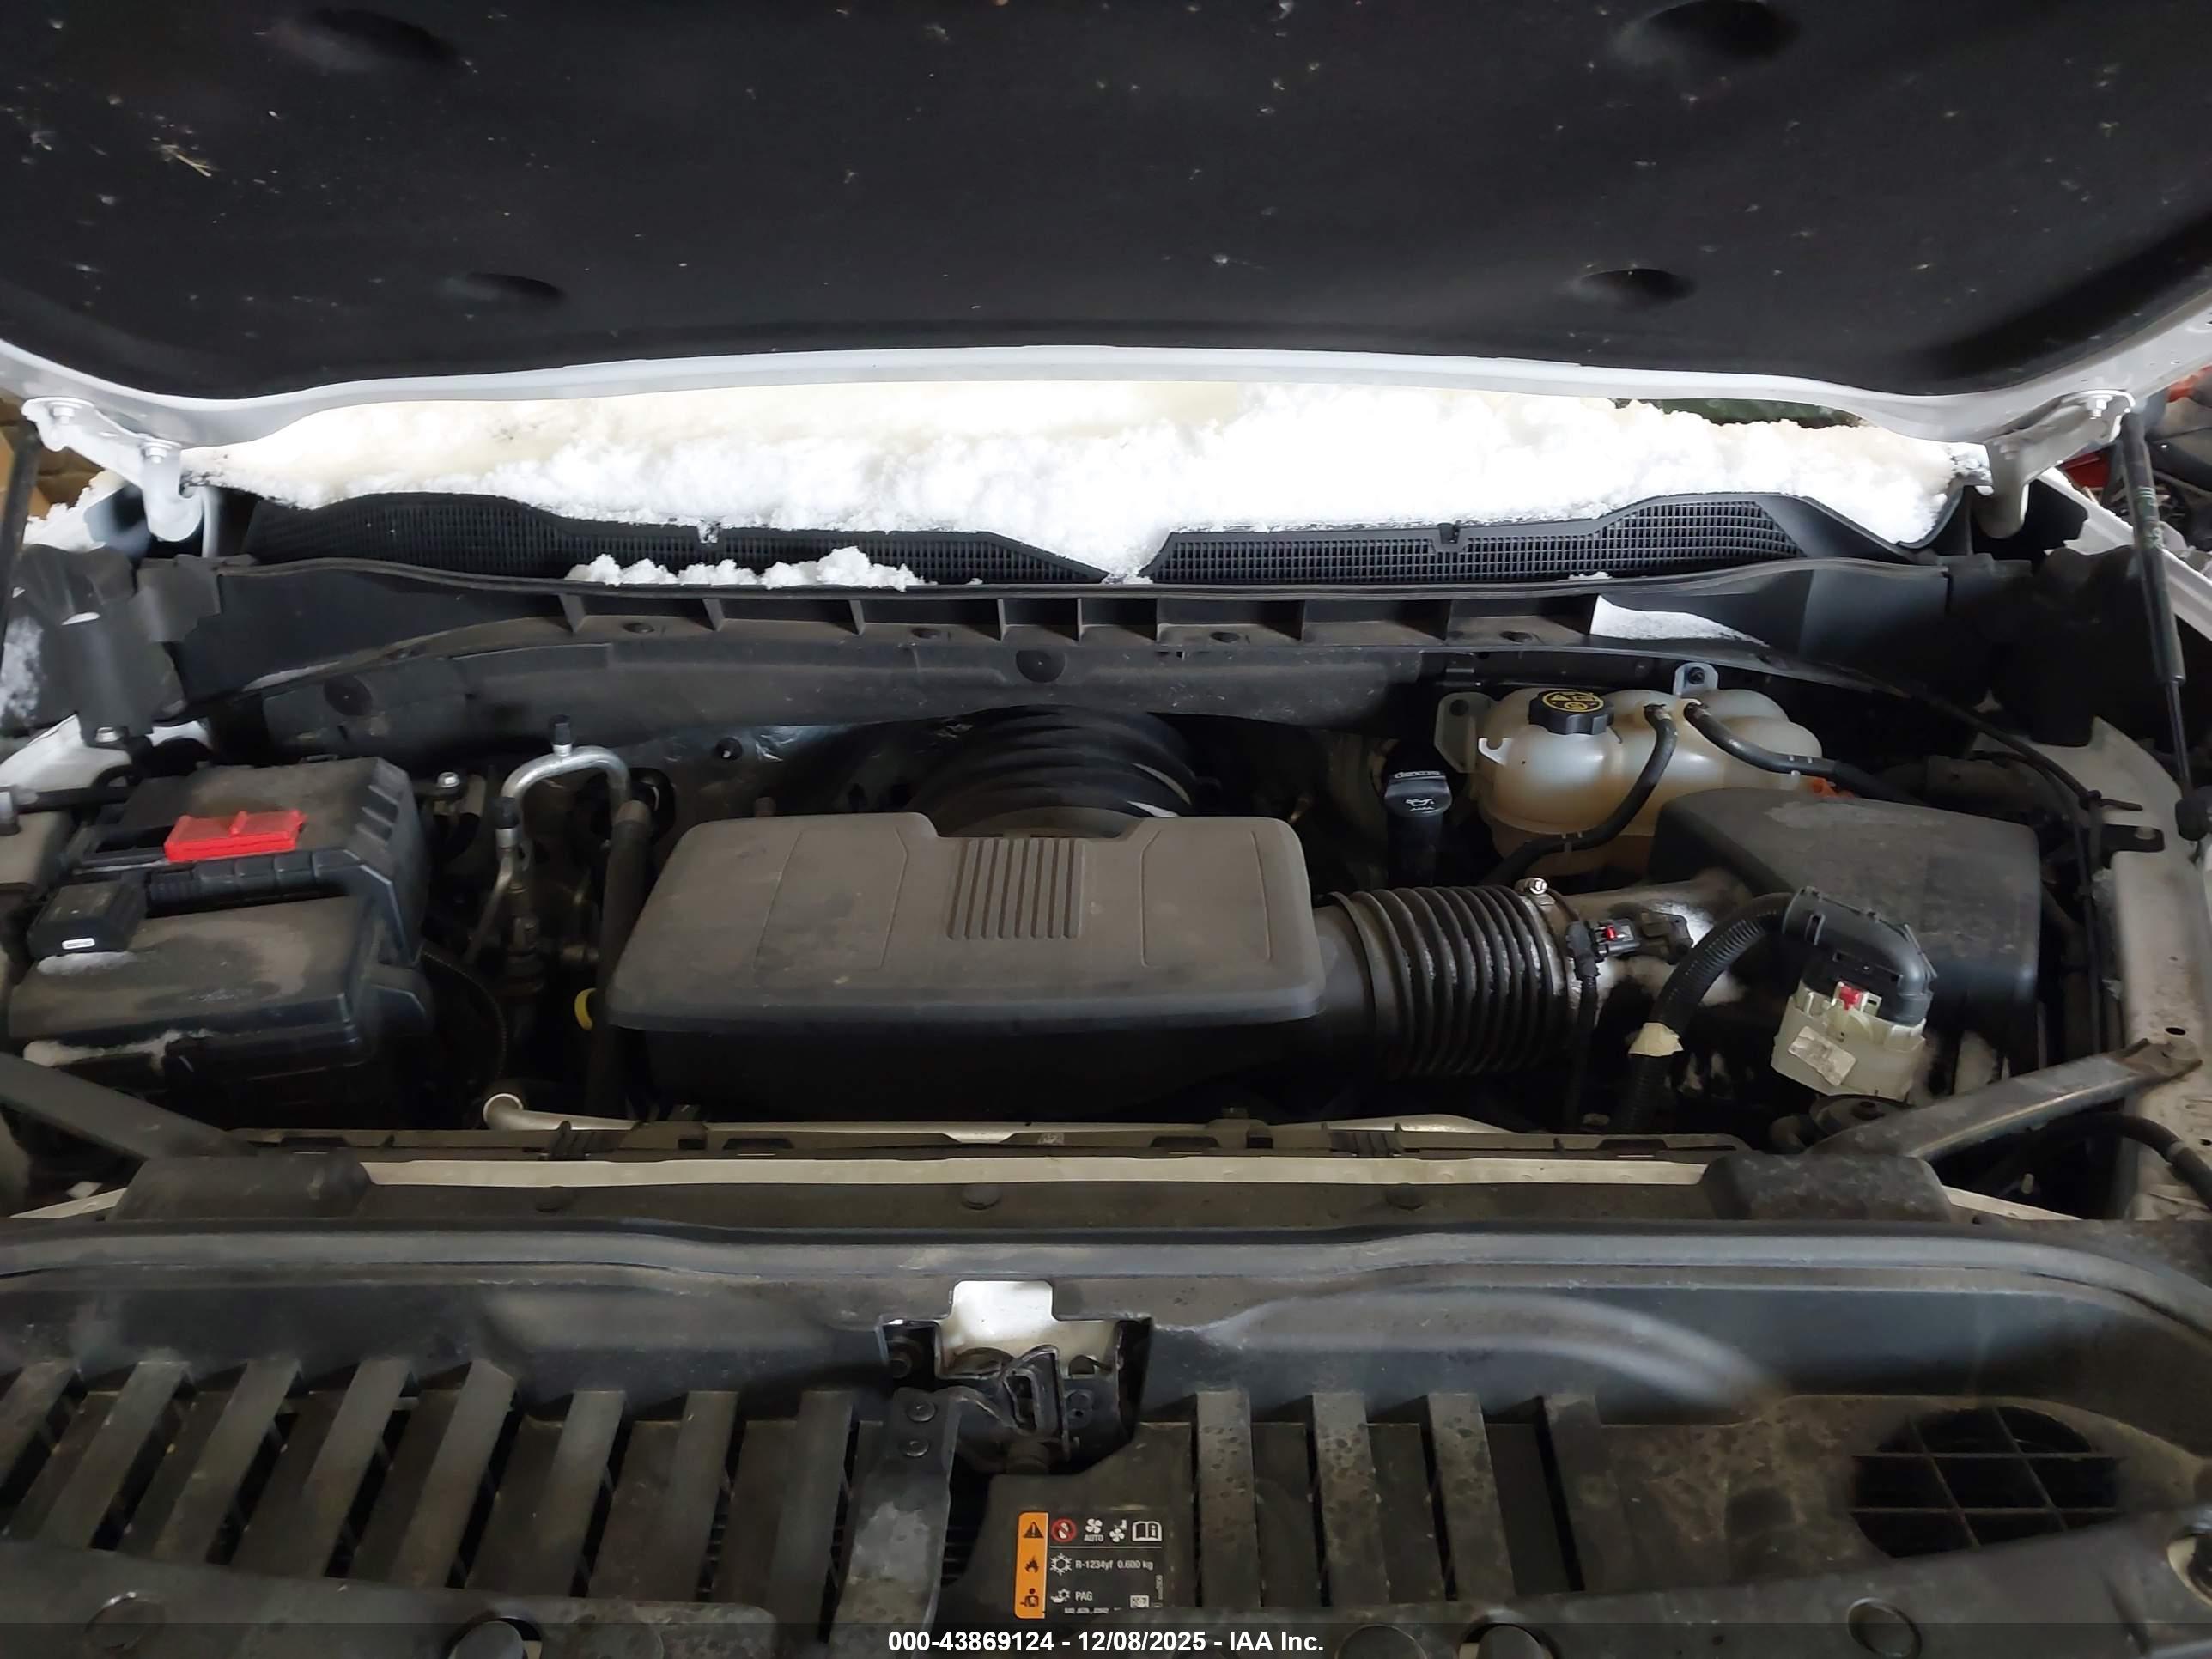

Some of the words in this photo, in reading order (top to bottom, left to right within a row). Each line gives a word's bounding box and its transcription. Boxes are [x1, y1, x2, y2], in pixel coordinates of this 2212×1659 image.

[1083, 1534, 1105, 1542] AUTO
[1075, 1559, 1114, 1571] R-1234yf
[1142, 1560, 1154, 1571] kg
[1075, 1590, 1093, 1601] PAG
